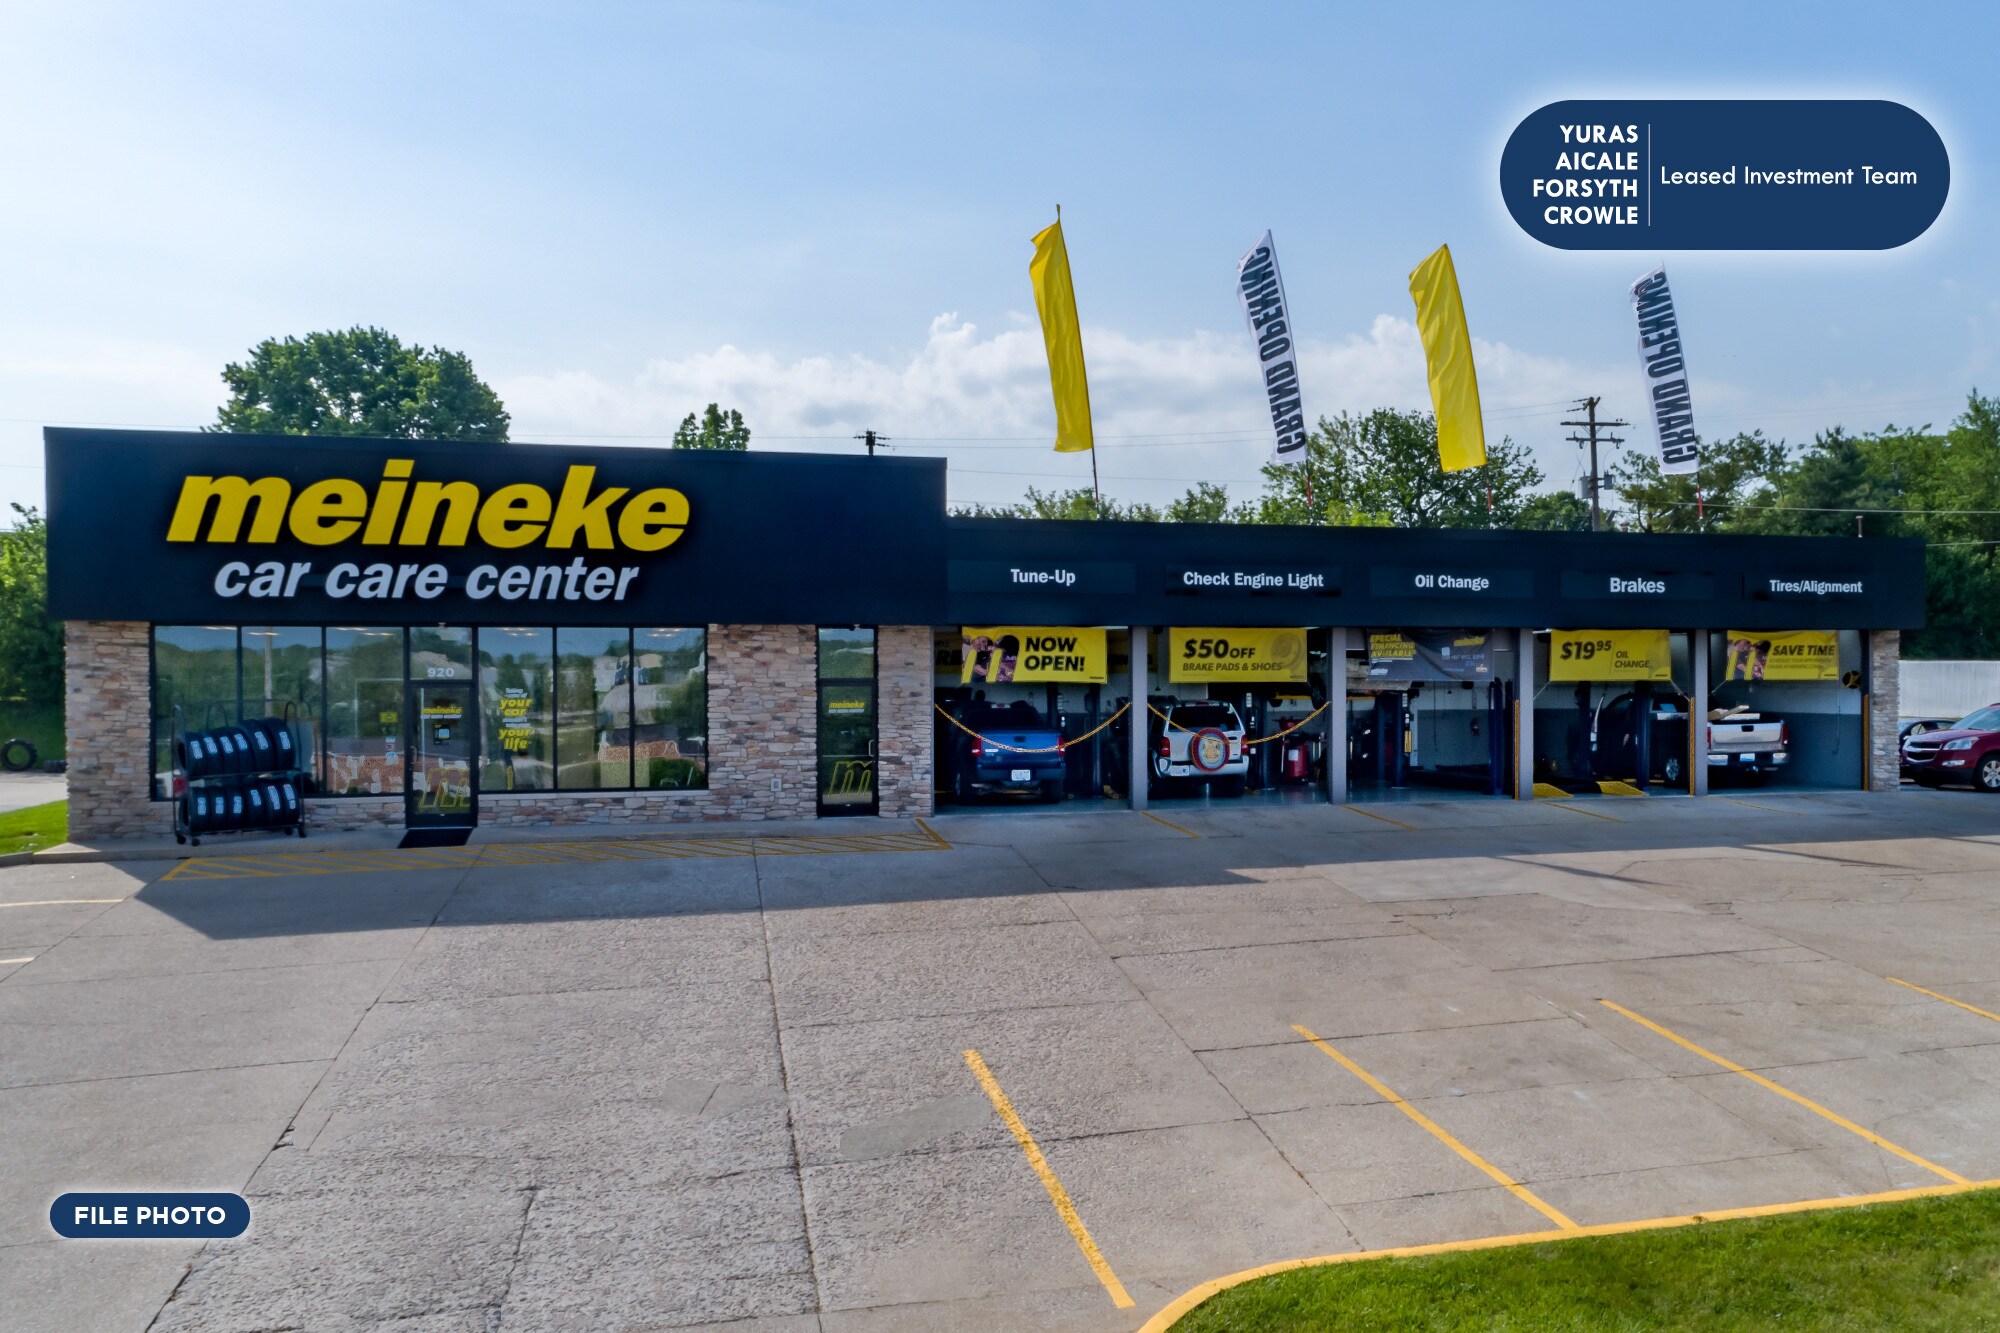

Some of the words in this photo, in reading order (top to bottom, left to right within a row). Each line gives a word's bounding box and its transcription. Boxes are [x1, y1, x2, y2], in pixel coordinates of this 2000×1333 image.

[166, 458, 690, 552] meineke
[213, 560, 312, 598] car
[324, 560, 449, 599] care
[464, 556, 640, 601] center
[1010, 568, 1076, 587] Tune-Up
[1183, 571, 1230, 586] Check
[1234, 572, 1284, 589] Engine
[1287, 573, 1324, 589] Light
[1414, 574, 1434, 588] Oil
[1437, 575, 1490, 591] Change
[1609, 577, 1666, 593] Brakes
[1769, 579, 1863, 595] Tires/Alignment
[1025, 637, 1078, 652] NOW
[1182, 638, 1229, 660] $50
[1229, 647, 1256, 659] OFF
[1772, 644, 1805, 656] SAVE
[1807, 644, 1836, 656] TIME
[1615, 651, 1629, 659] OIL
[1024, 655, 1086, 672] OPEN!
[1182, 662, 1214, 672] BRAKE
[1215, 662, 1241, 672] PADS
[1242, 662, 1249, 671] &
[1614, 660, 1650, 668] CHANGE
[427, 667, 455, 678] 920
[500, 698, 533, 710] your
[504, 708, 527, 717] car
[498, 729, 532, 741] your
[504, 737, 528, 752] life
